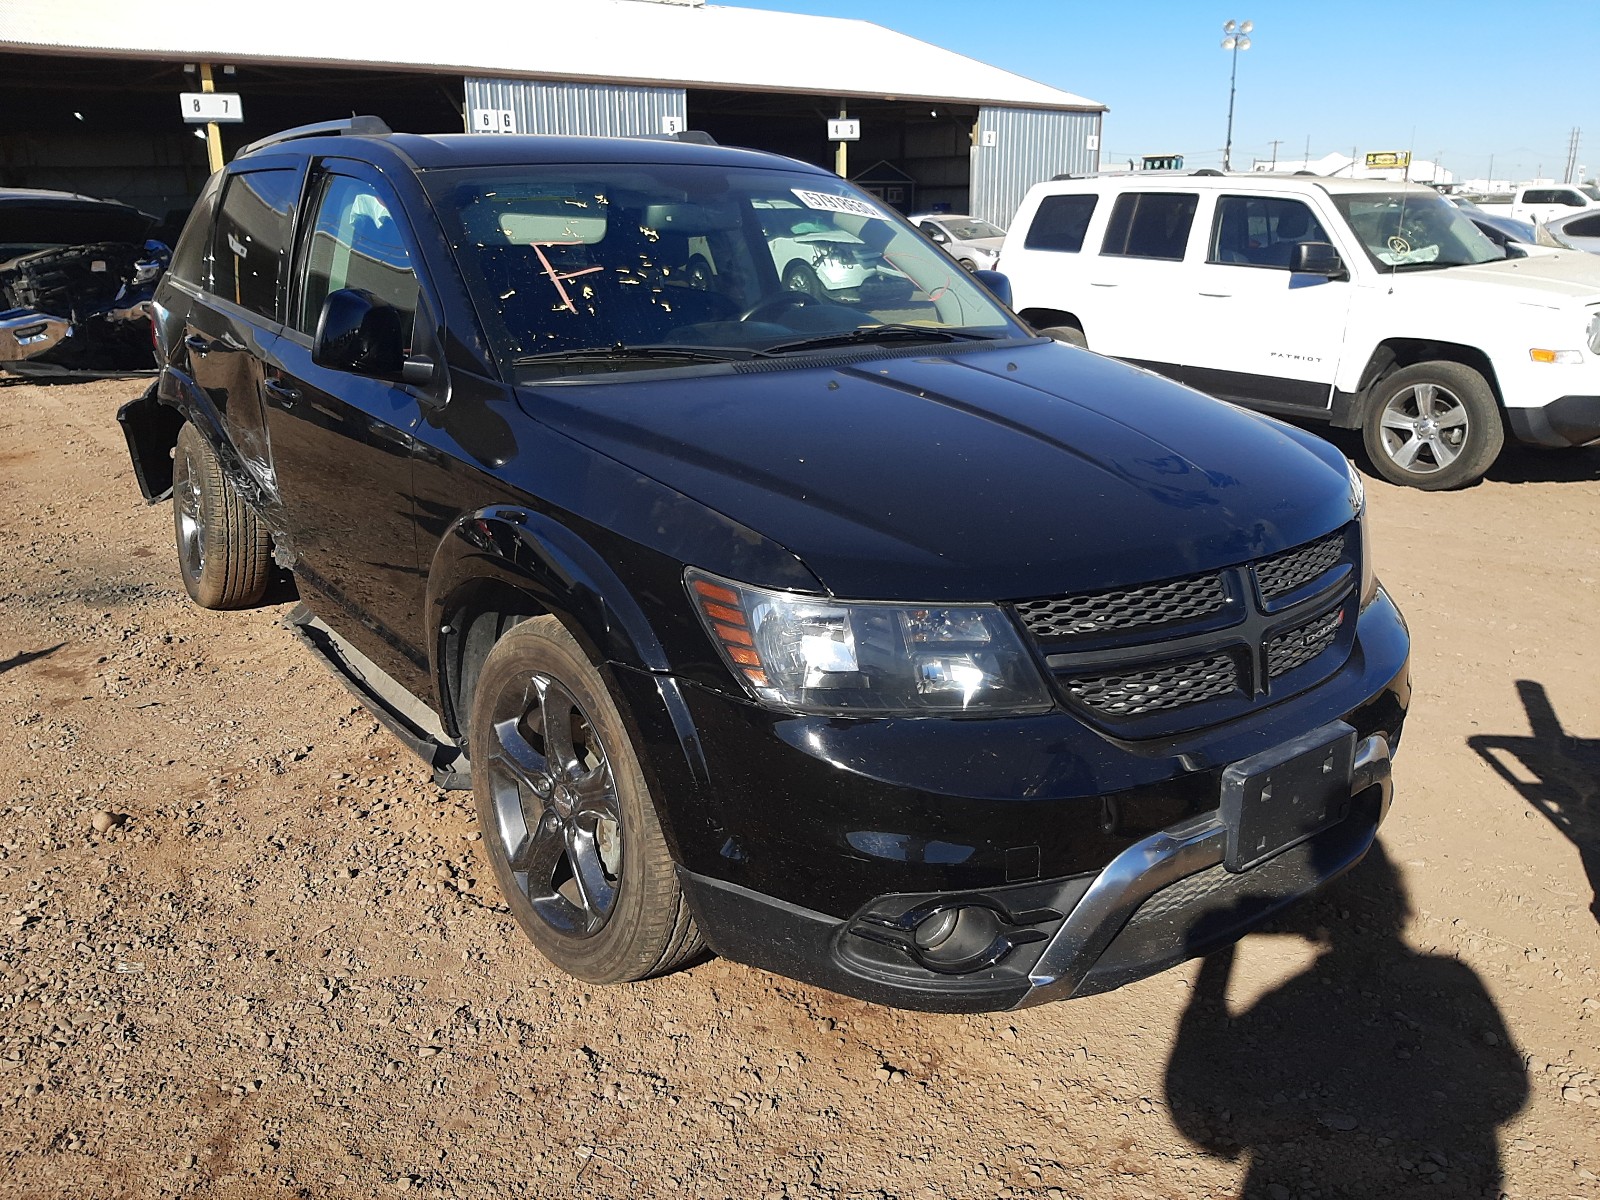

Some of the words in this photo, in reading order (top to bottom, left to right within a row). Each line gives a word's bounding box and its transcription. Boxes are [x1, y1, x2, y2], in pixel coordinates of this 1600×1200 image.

[193, 99, 201, 112] 8
[222, 100, 229, 113] 7
[483, 113, 490, 126] 6
[669, 121, 675, 131] 5
[834, 124, 839, 134] 4
[849, 124, 854, 134] 3
[1271, 352, 1322, 362] PATRIOT
